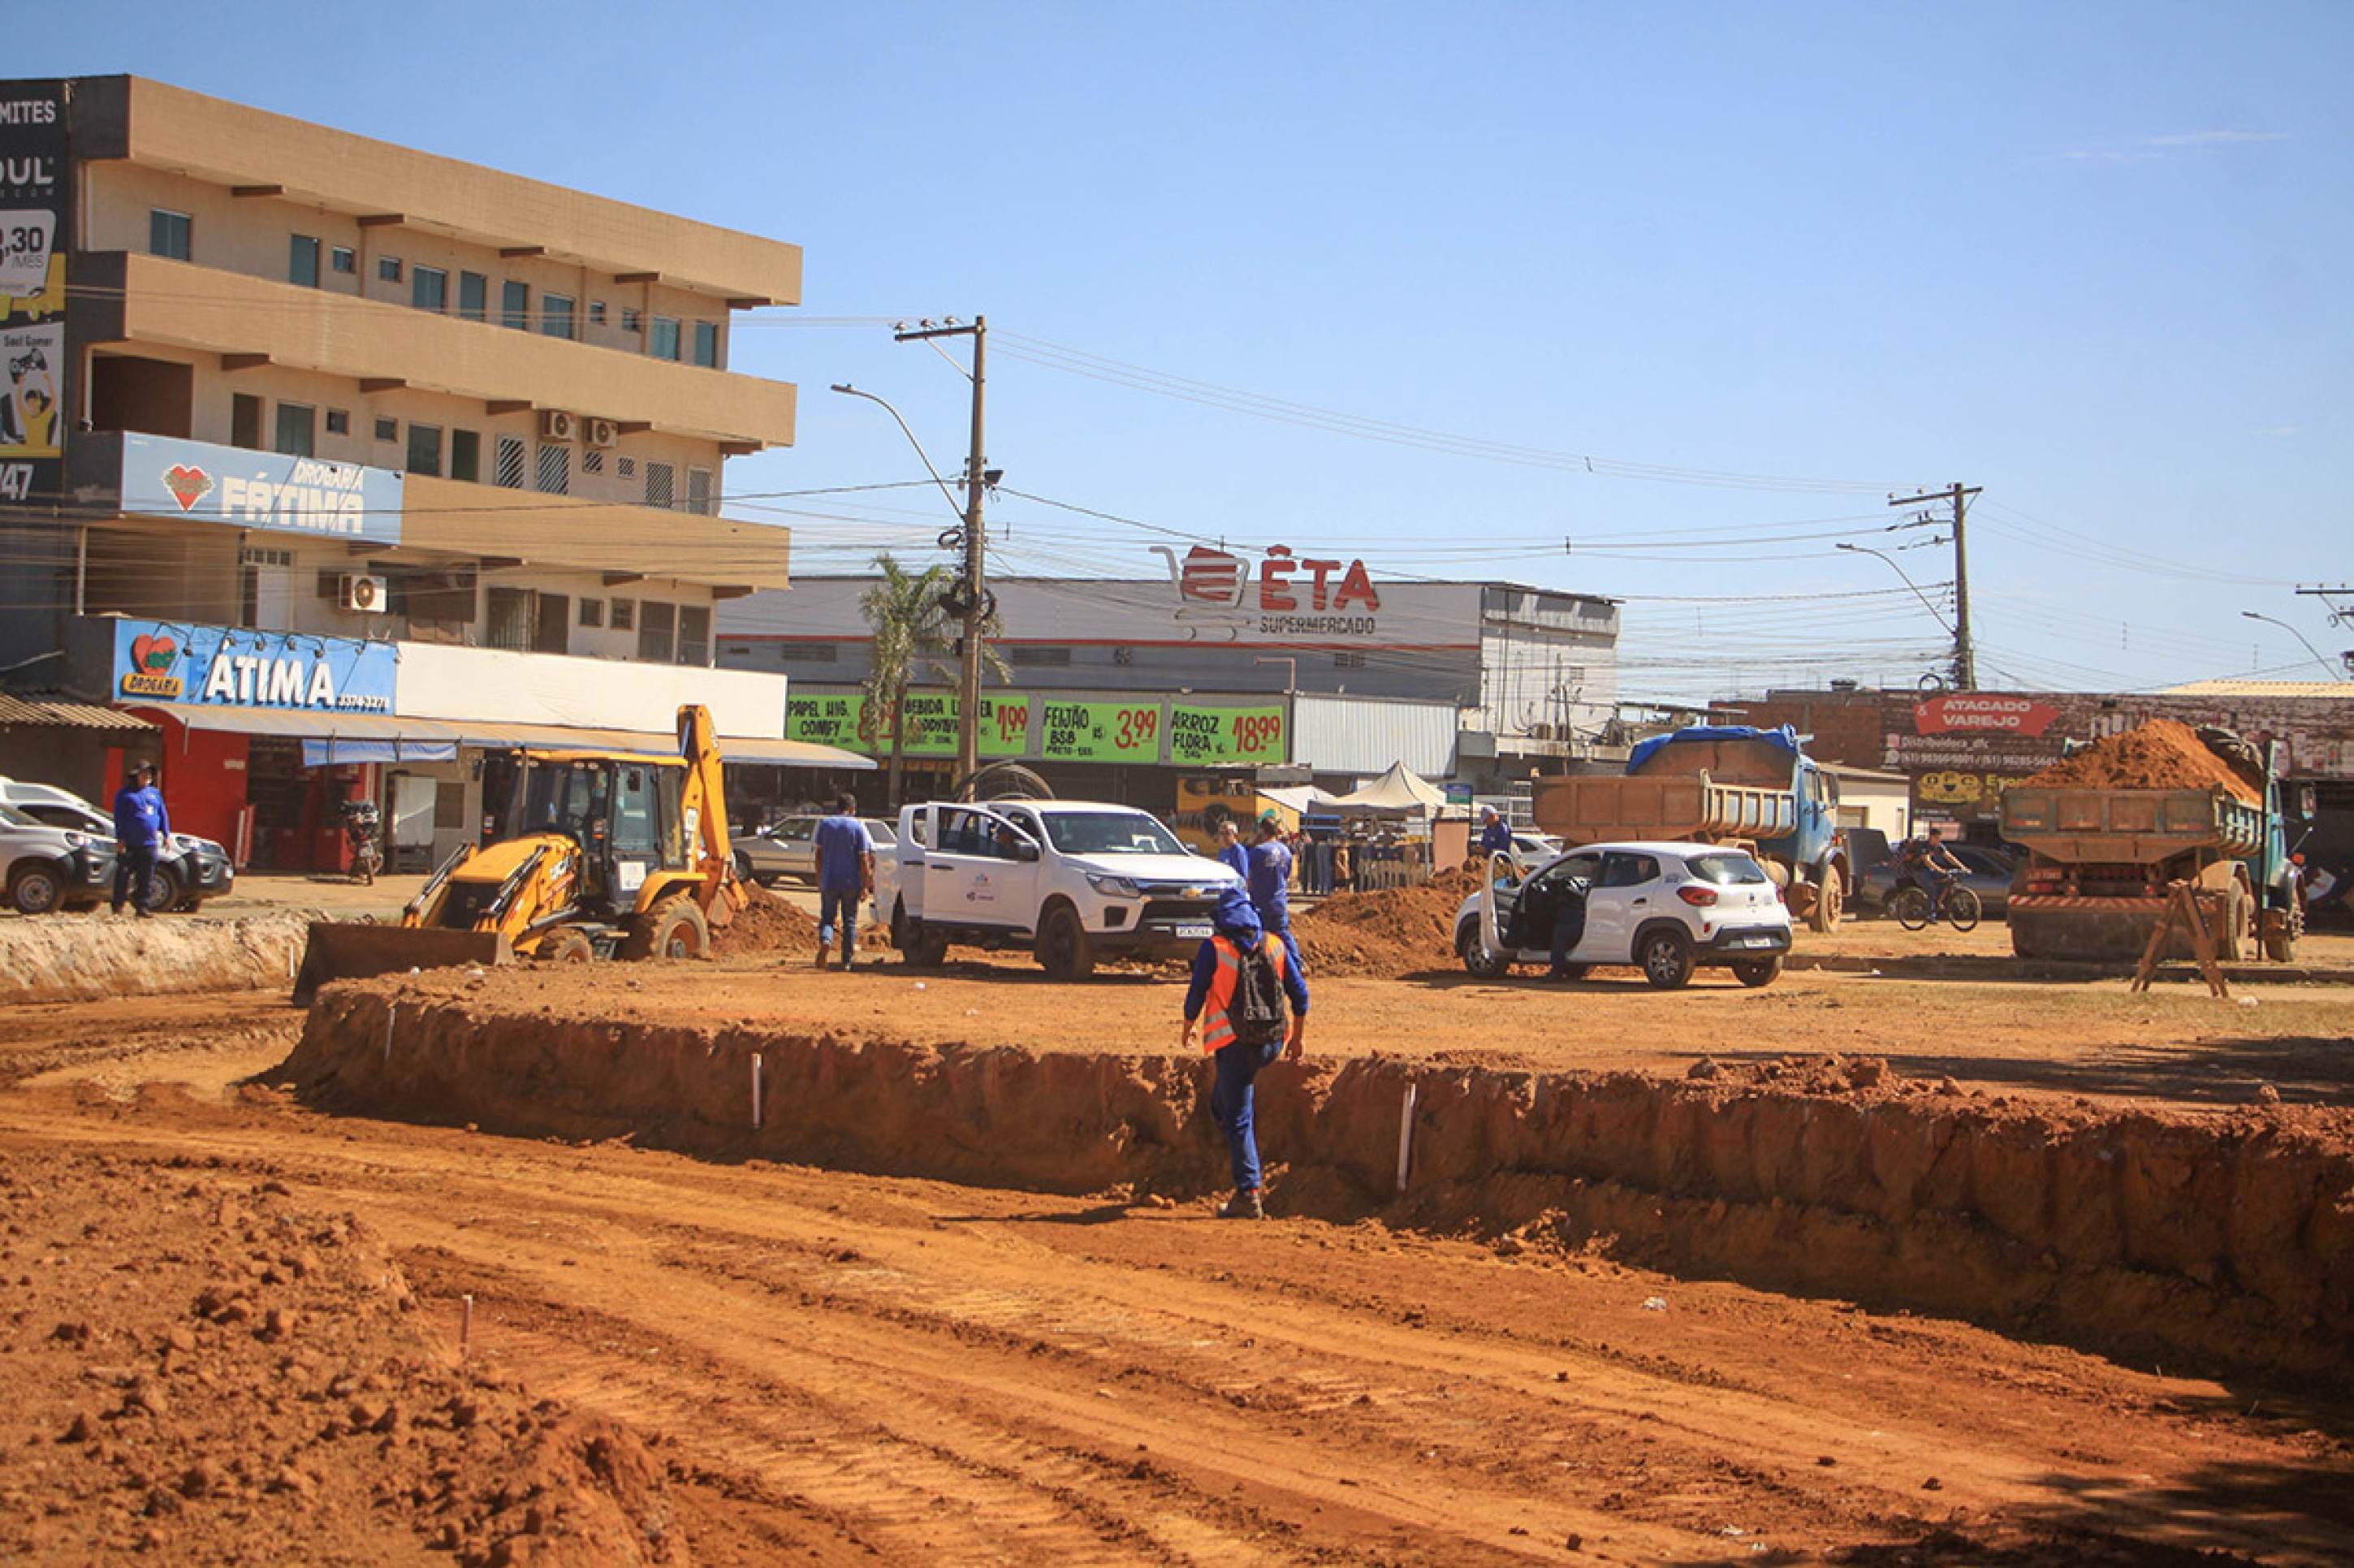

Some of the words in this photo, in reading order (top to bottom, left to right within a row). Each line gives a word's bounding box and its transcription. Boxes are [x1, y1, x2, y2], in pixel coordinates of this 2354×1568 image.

[0, 157, 54, 185] UL
[221, 471, 364, 533] FÁTIMA
[1260, 544, 1380, 611] ÊTA
[1259, 616, 1376, 634] SUPERMERCADO
[1942, 701, 2031, 712] ATACADO
[1172, 711, 1220, 734] ARROZ
[1942, 715, 2020, 727] VAREJO
[1173, 732, 1211, 752] FLORA
